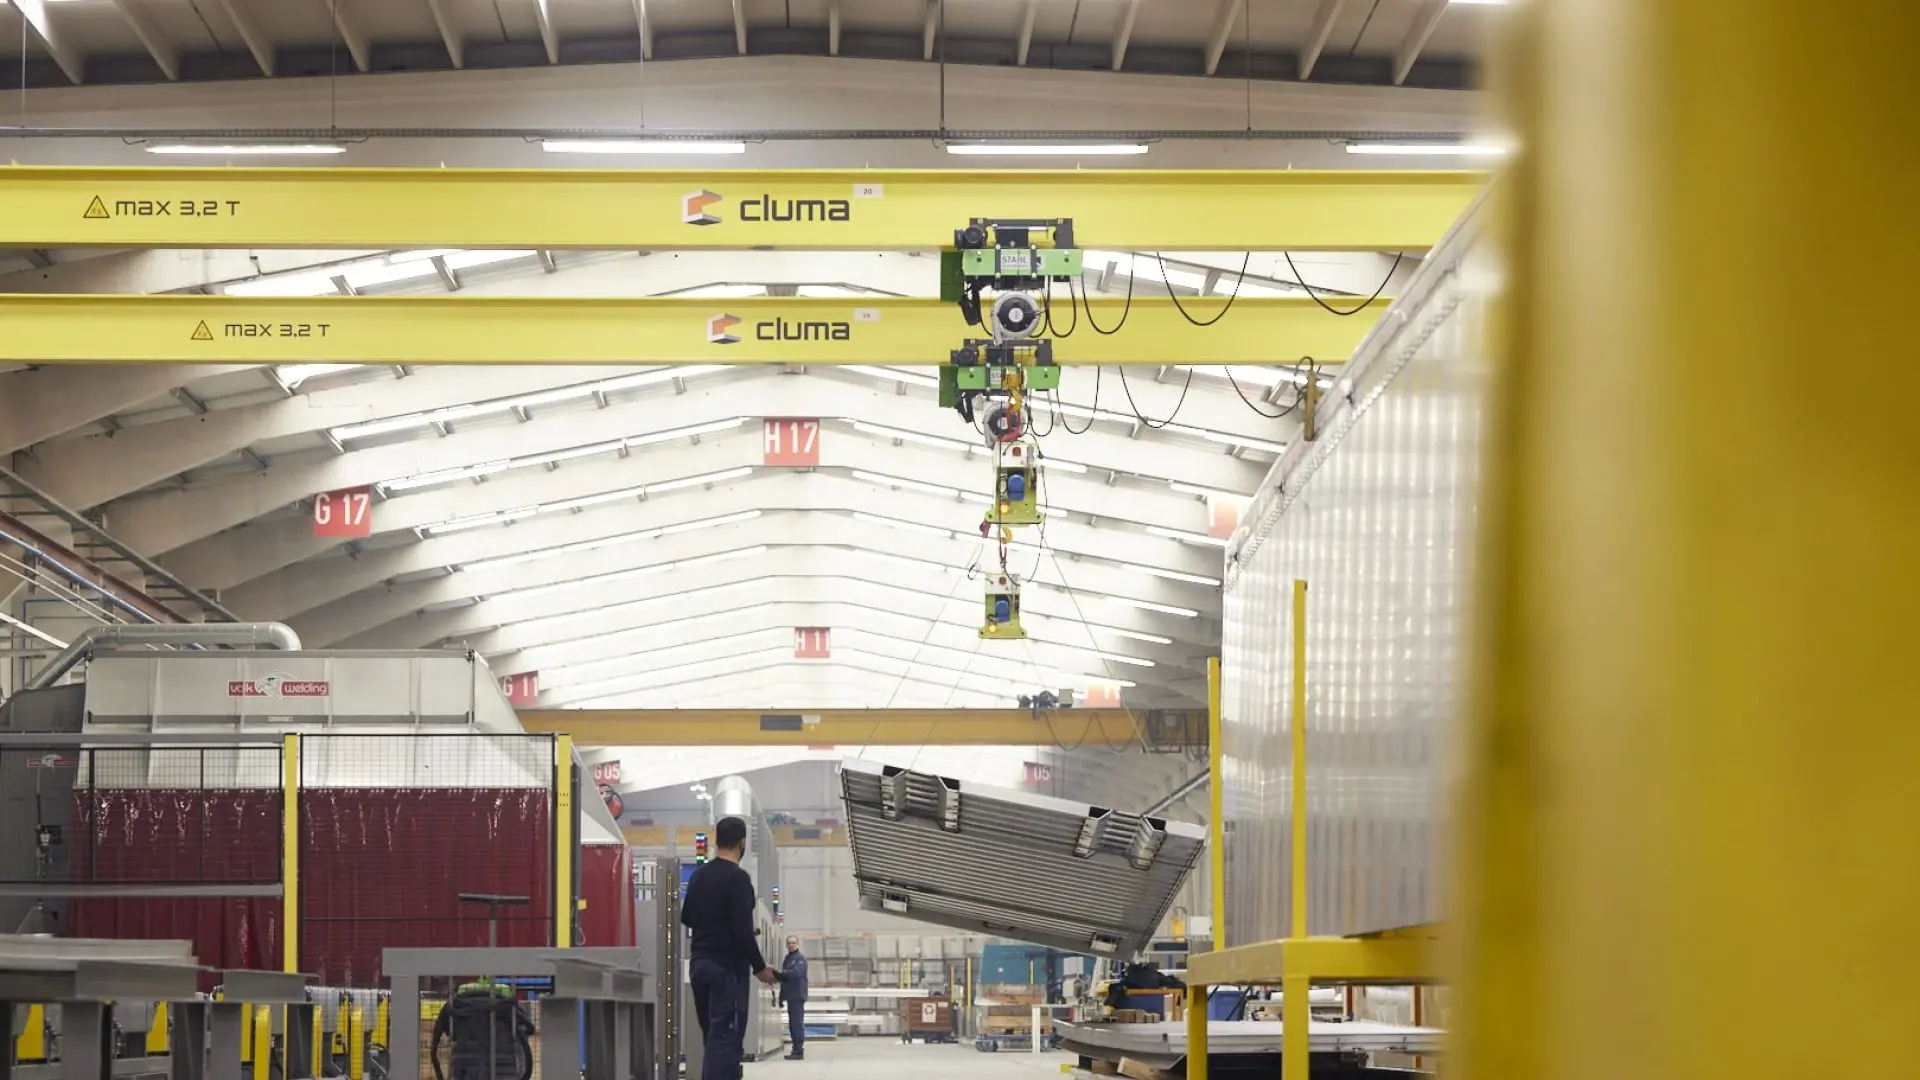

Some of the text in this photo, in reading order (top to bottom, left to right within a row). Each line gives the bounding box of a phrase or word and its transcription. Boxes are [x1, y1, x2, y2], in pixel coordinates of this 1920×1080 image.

[115, 200, 240, 218] max 3,2 T
[739, 193, 850, 222] cluma
[224, 323, 272, 338] max
[318, 323, 330, 337] T
[756, 316, 850, 341] cluma
[764, 421, 818, 454] H 17
[315, 493, 369, 525] G 17
[795, 629, 830, 651] H 11
[285, 682, 327, 695] welding
[503, 674, 538, 697] G 11
[604, 763, 620, 780] 05
